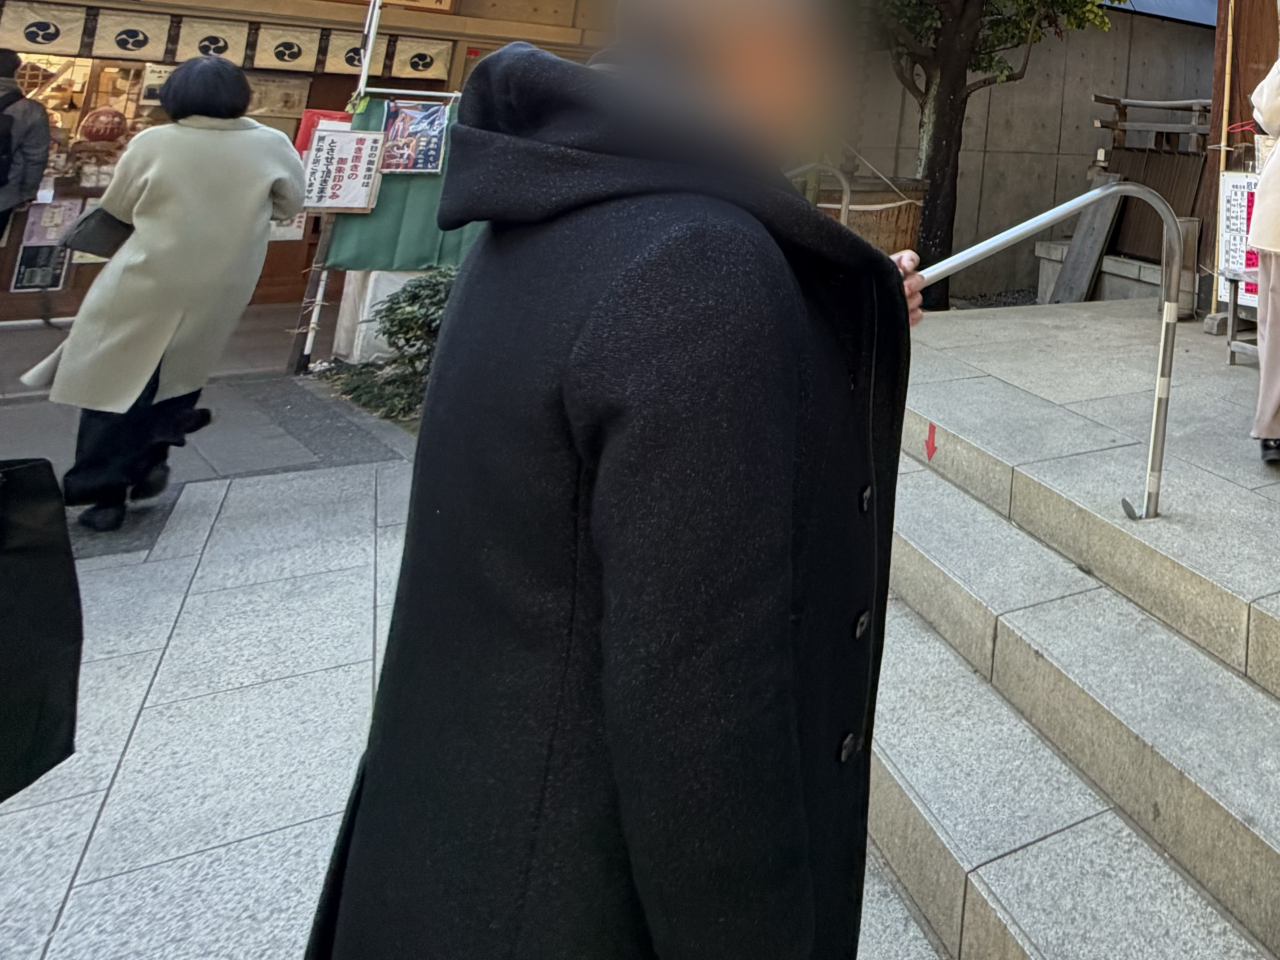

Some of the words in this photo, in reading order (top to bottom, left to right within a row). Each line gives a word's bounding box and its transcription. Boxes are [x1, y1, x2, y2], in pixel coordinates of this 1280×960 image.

[328, 157, 349, 201] 御朱印のみ
[347, 137, 367, 181] 書き置きの
[361, 138, 380, 188] 本日の御朱印は
